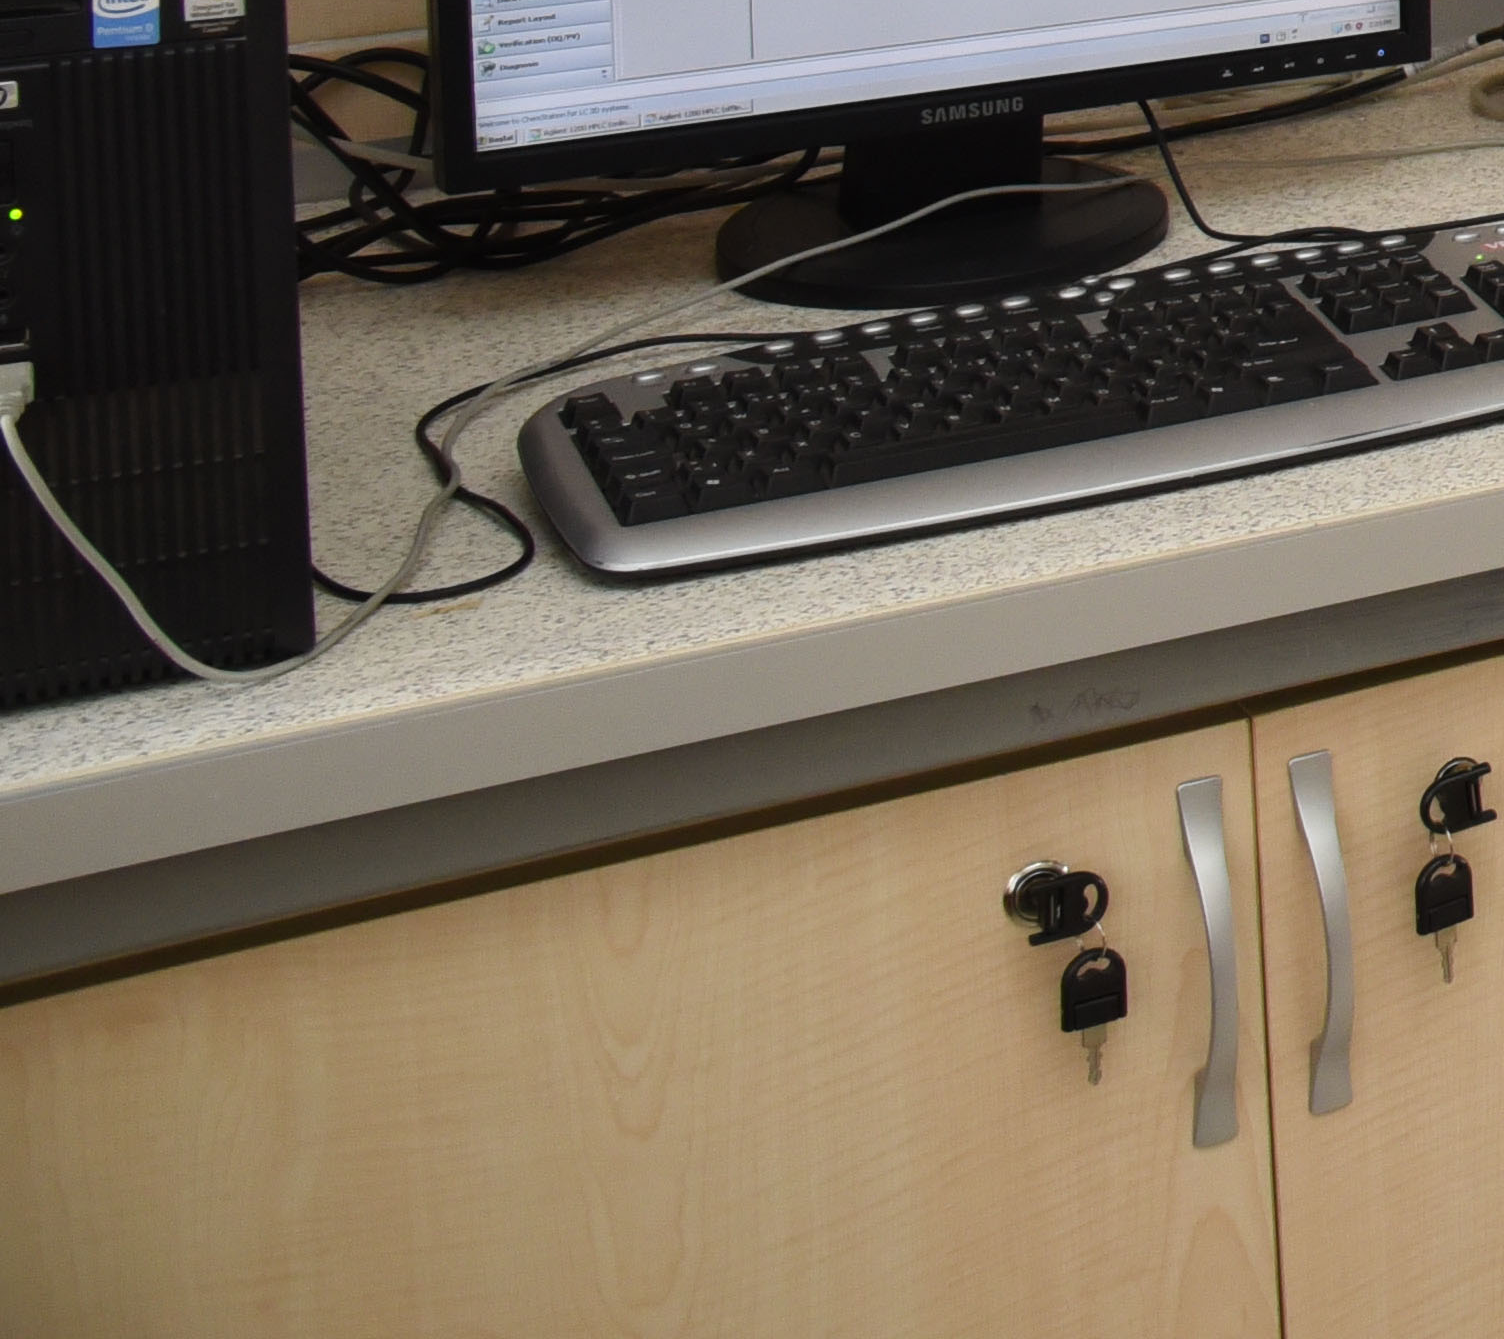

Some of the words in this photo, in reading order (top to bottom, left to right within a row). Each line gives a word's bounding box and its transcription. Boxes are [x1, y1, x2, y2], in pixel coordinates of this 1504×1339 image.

[498, 15, 526, 27] Report
[528, 12, 556, 24] Layout
[921, 96, 1024, 125] SAMSUNG
